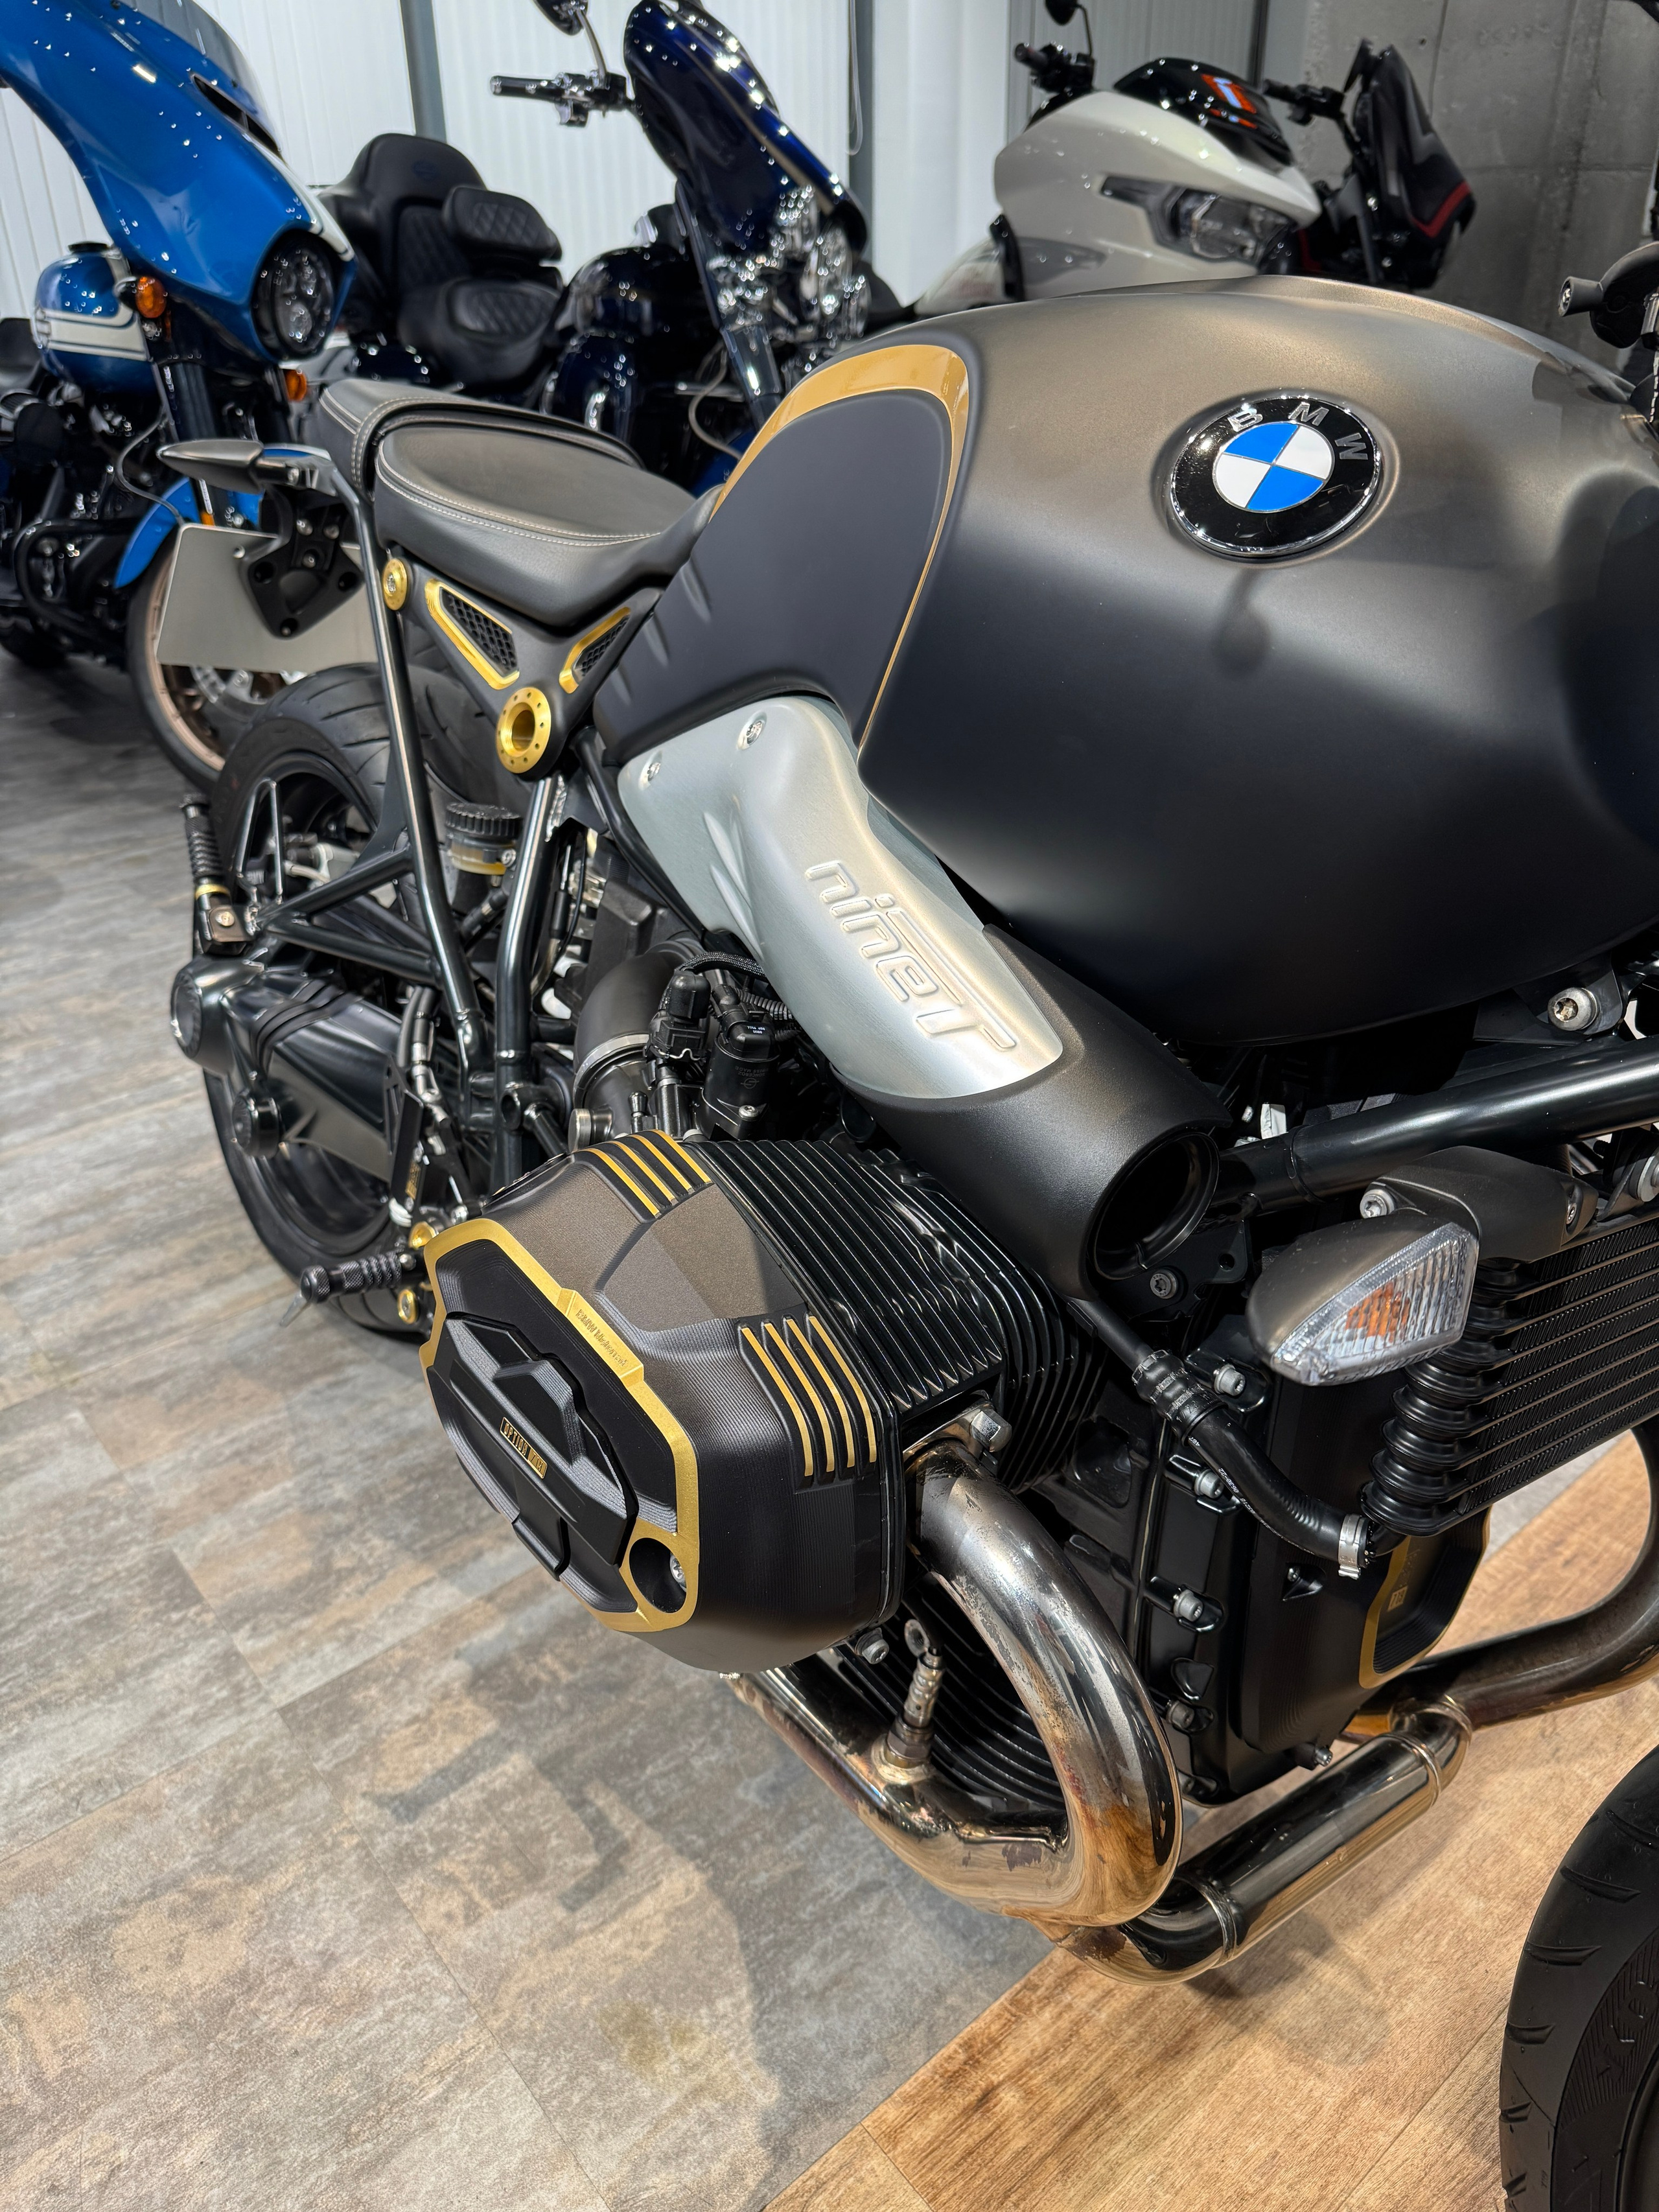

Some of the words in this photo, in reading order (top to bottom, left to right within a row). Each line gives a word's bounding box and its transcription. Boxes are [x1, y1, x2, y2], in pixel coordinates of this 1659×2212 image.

[1227, 402, 1368, 460] BMW
[805, 859, 1017, 1051] nineT
[575, 1309, 597, 1333] BMW
[503, 1422, 529, 1456] OPTION
